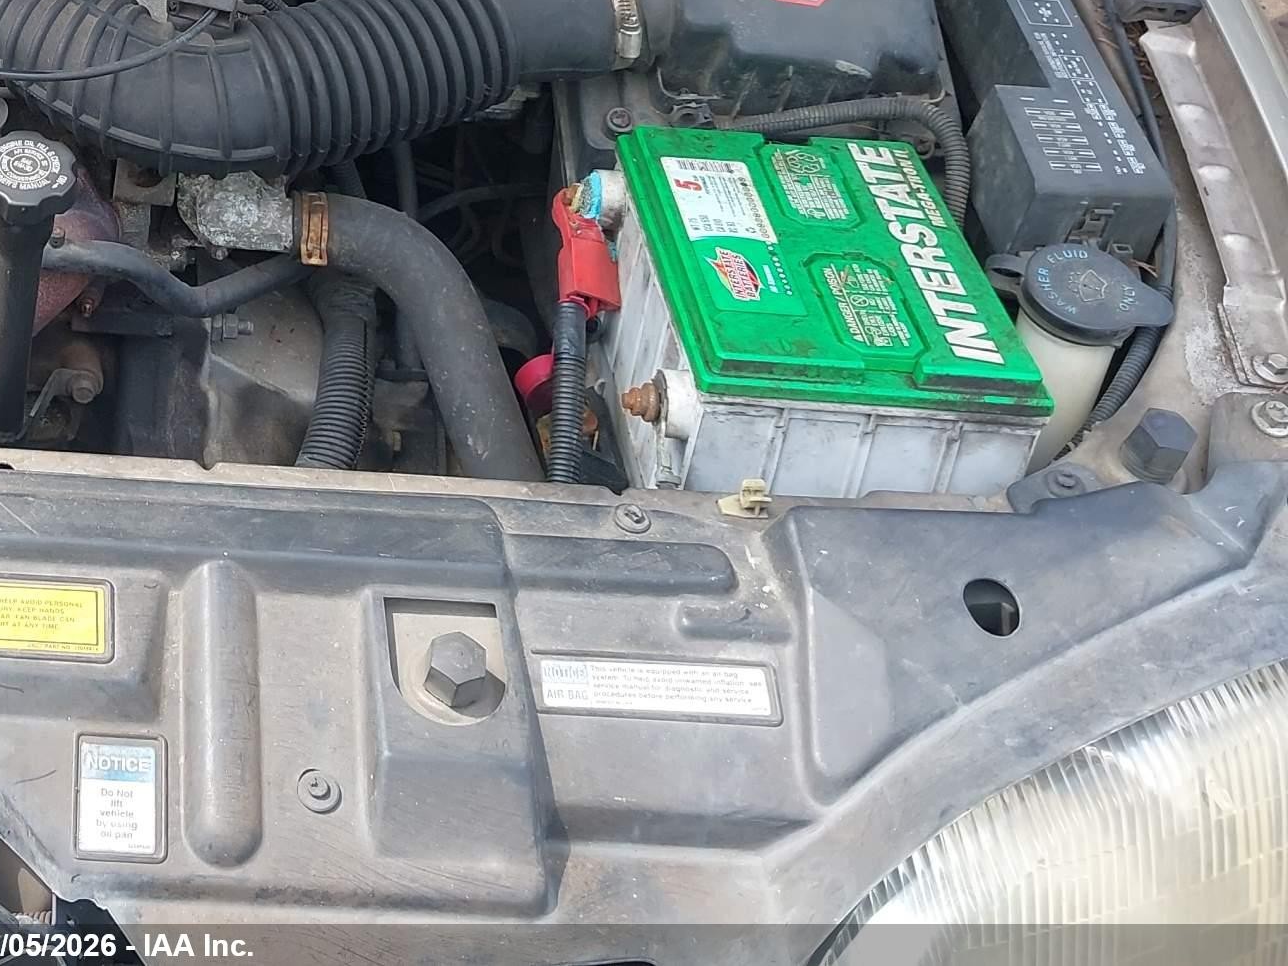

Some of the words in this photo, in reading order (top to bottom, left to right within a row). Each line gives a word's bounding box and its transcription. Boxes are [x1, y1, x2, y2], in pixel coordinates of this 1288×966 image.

[24, 140, 35, 148] OIL
[36, 142, 49, 152] FILL
[19, 179, 52, 190] MANUAL
[674, 178, 702, 191] 5
[846, 142, 1005, 365] INTERSTATE
[1047, 249, 1088, 264] FLUID
[720, 250, 747, 298] INTERSTATE
[732, 254, 756, 298] BATTERIES
[822, 267, 844, 296] POISON
[1037, 268, 1077, 315] WASHER
[1119, 284, 1136, 311] ONLY
[838, 303, 863, 336] DANGER
[44, 601, 83, 609] PERSONAL
[545, 688, 564, 699] AIR
[567, 689, 588, 700] BAG
[88, 750, 152, 772] NOTICE
[101, 788, 113, 797] Do
[117, 790, 133, 798] Not
[100, 809, 134, 818] vehicle
[96, 819, 107, 828] by
[110, 820, 138, 831] using
[100, 830, 112, 838] oil
